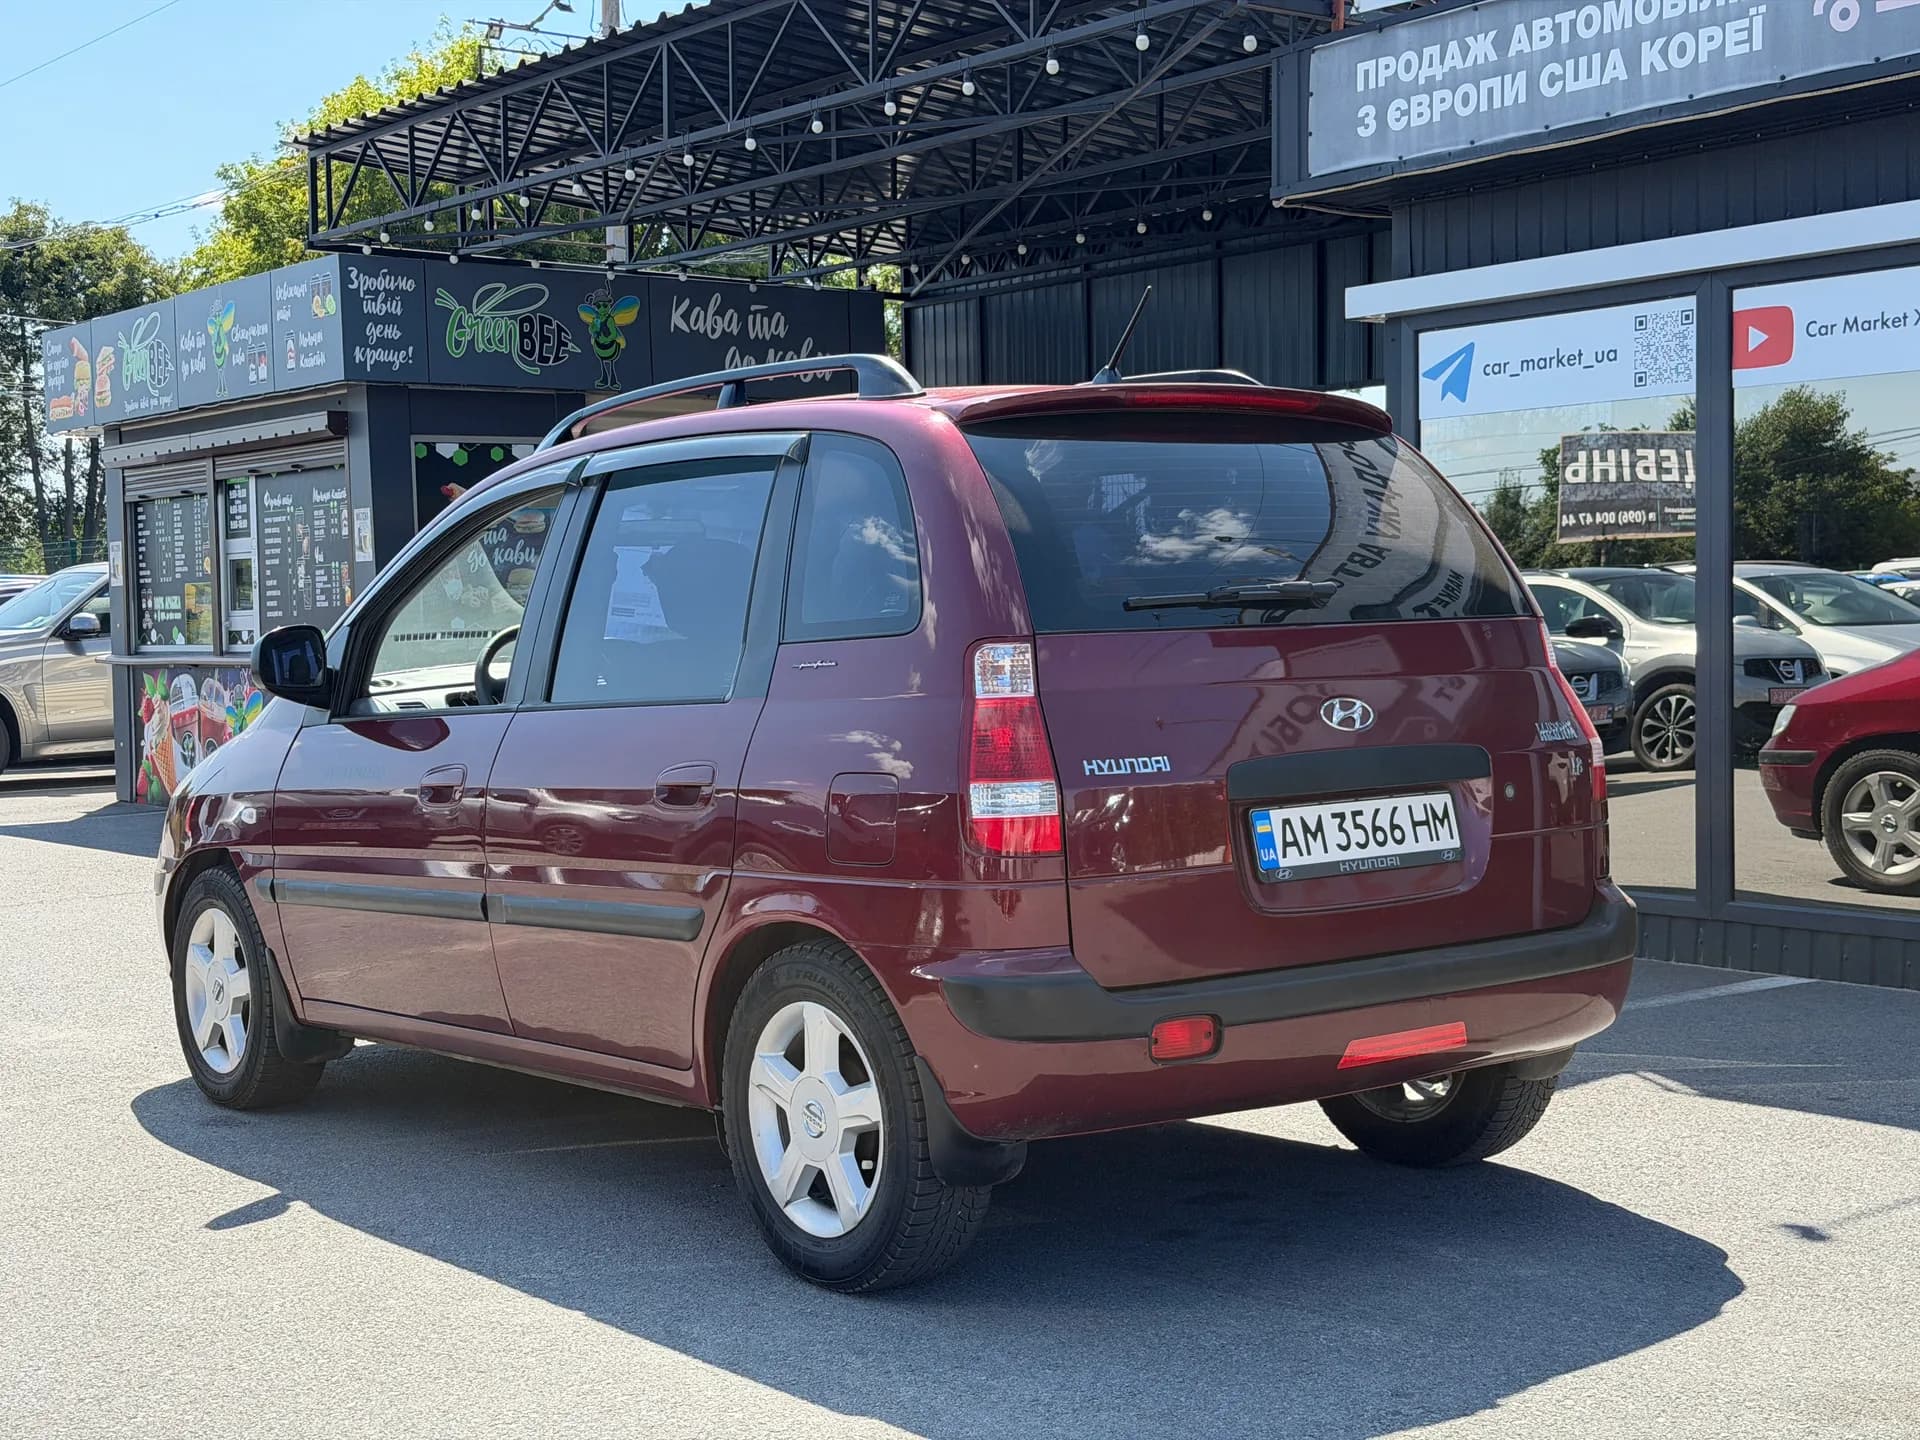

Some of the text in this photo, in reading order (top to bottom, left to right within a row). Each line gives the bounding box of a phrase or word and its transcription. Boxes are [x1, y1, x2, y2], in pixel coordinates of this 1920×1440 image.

[1357, 0, 1742, 92] ПРОДАЖ АВТОМОБ
[1357, 4, 1767, 137] З ЄВРОПИ США КОРЕЇ
[347, 266, 416, 298] Зробимо
[363, 292, 403, 316] твій
[671, 293, 788, 341] Кава та
[366, 322, 402, 345] день
[1805, 320, 1838, 338] Car
[1842, 311, 1909, 334] Market
[353, 345, 413, 373] краще!
[1483, 347, 1618, 377] car_market_ua
[1083, 755, 1171, 776] HYUNDAI
[1281, 801, 1455, 859] AM 3566 HM
[1260, 847, 1278, 862] UA
[1339, 856, 1401, 872] HYUNDAI
